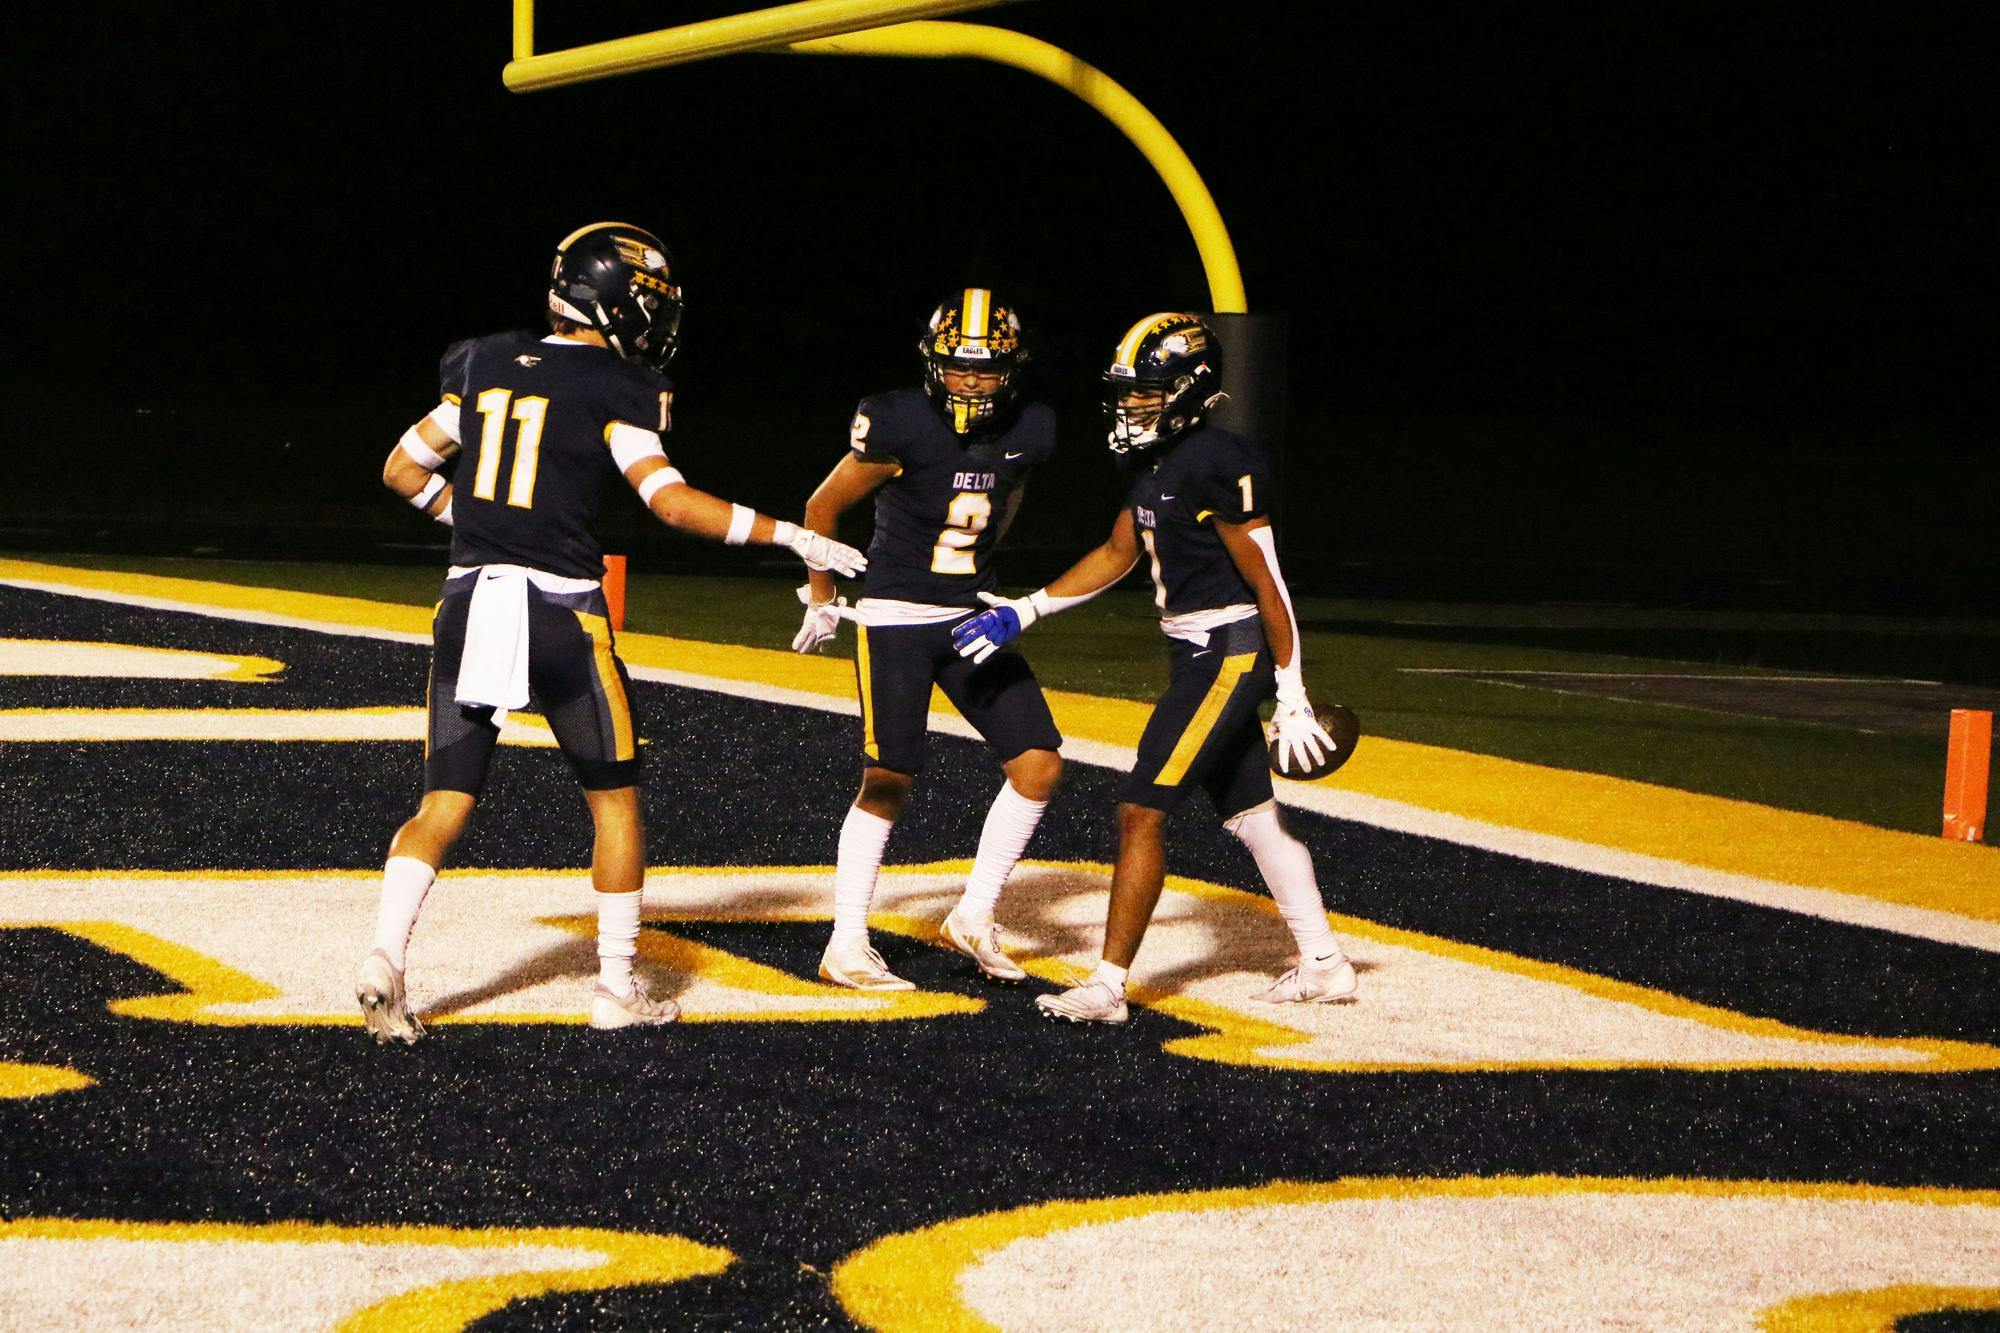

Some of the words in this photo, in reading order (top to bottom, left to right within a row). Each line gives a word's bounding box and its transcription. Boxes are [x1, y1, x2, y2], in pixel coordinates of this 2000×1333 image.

[472, 387, 550, 510] 11
[850, 412, 871, 454] 2
[952, 472, 995, 490] DELTA
[1237, 474, 1254, 513] 1
[930, 492, 993, 575] 2
